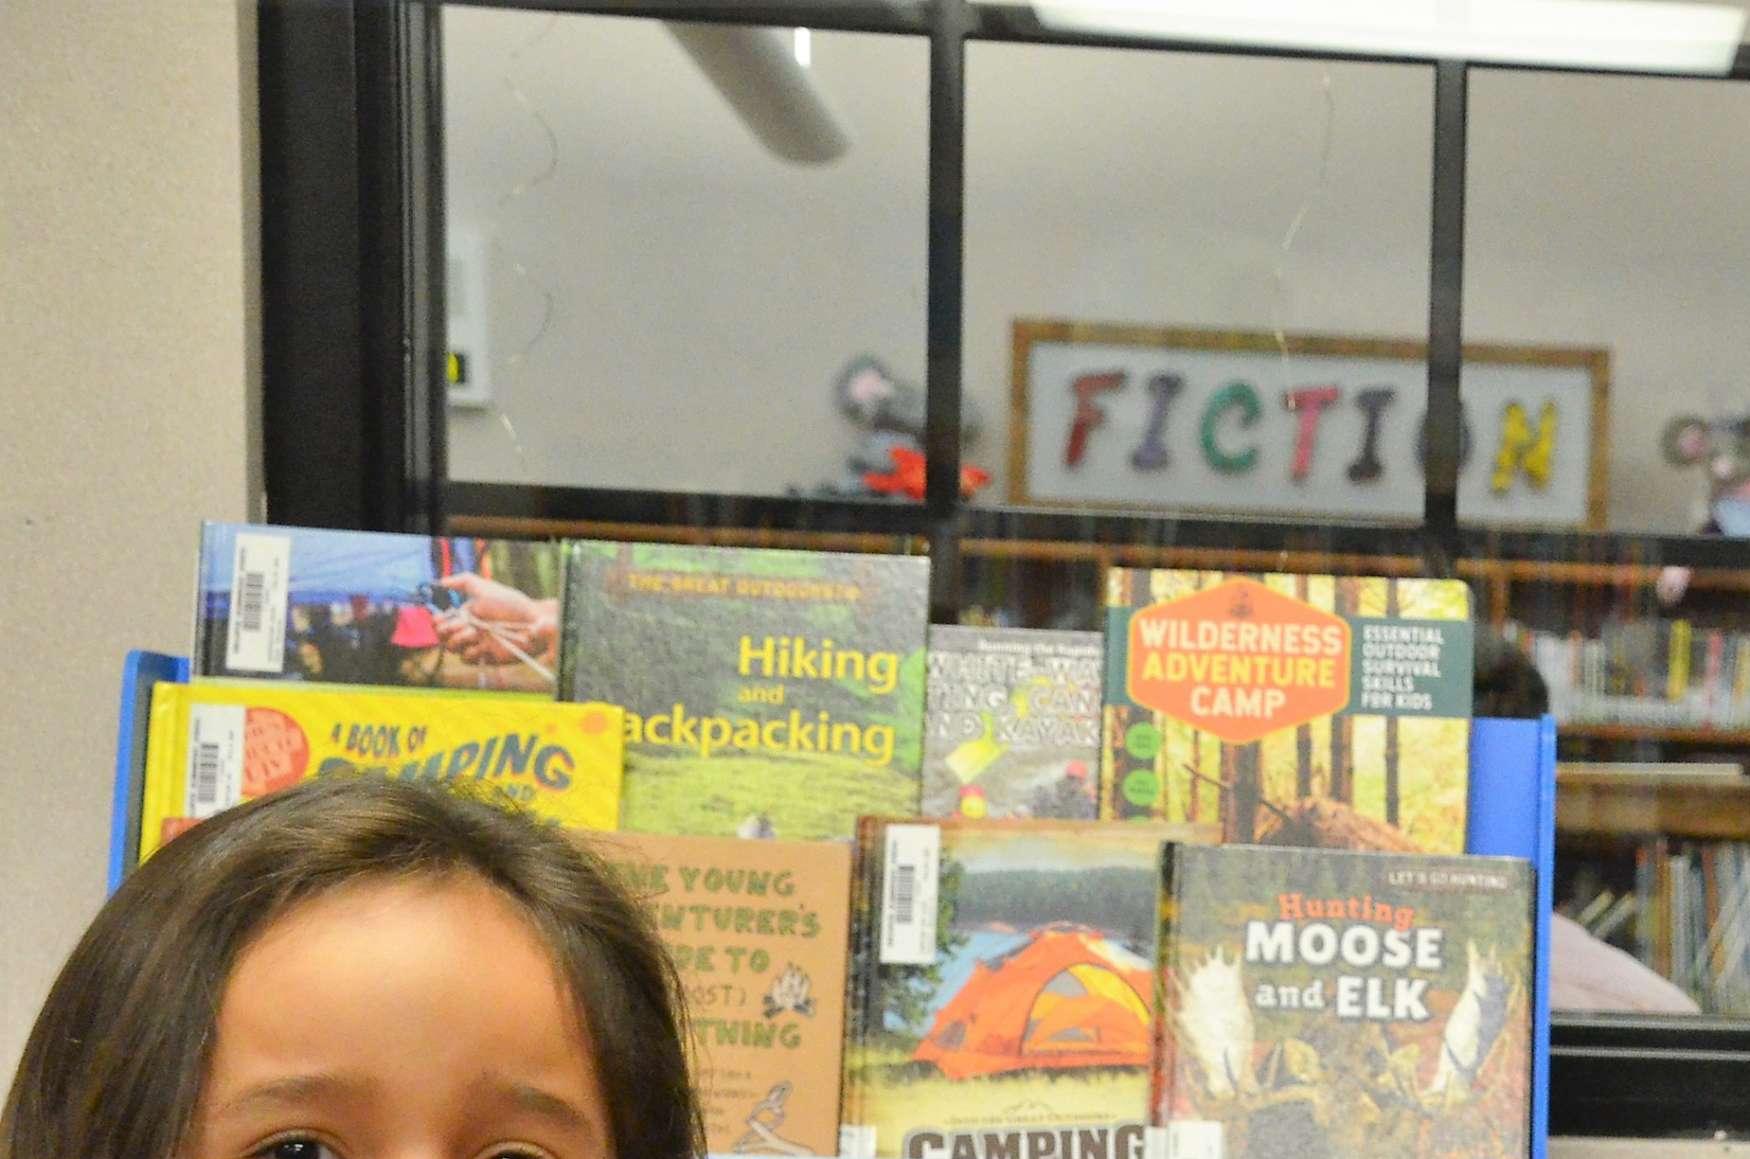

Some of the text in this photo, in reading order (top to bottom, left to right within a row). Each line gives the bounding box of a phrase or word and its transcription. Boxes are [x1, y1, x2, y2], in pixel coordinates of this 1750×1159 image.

[1139, 617, 1343, 656] WILDERNESS
[1362, 625, 1445, 644] ESSENTIAL
[738, 634, 899, 695] Hiking
[1362, 643, 1441, 660] OUTDOOR
[1362, 659, 1441, 677] SURVIVAL
[1142, 653, 1337, 688] ADVENTURE
[1361, 675, 1414, 692] SKILLS
[738, 683, 785, 705] and
[1189, 686, 1286, 719] CAMP
[1361, 691, 1393, 709] FOR
[346, 723, 400, 758] BOOK
[407, 725, 428, 752] OF
[623, 703, 896, 767] ackpacking
[679, 866, 796, 897] YOUNG
[655, 902, 820, 938] NTURER'S
[1278, 892, 1415, 931] Hunting
[725, 945, 770, 974] TO
[1246, 921, 1443, 969] MOOSE
[1255, 975, 1429, 1019] and ELK
[692, 1018, 801, 1050] THING
